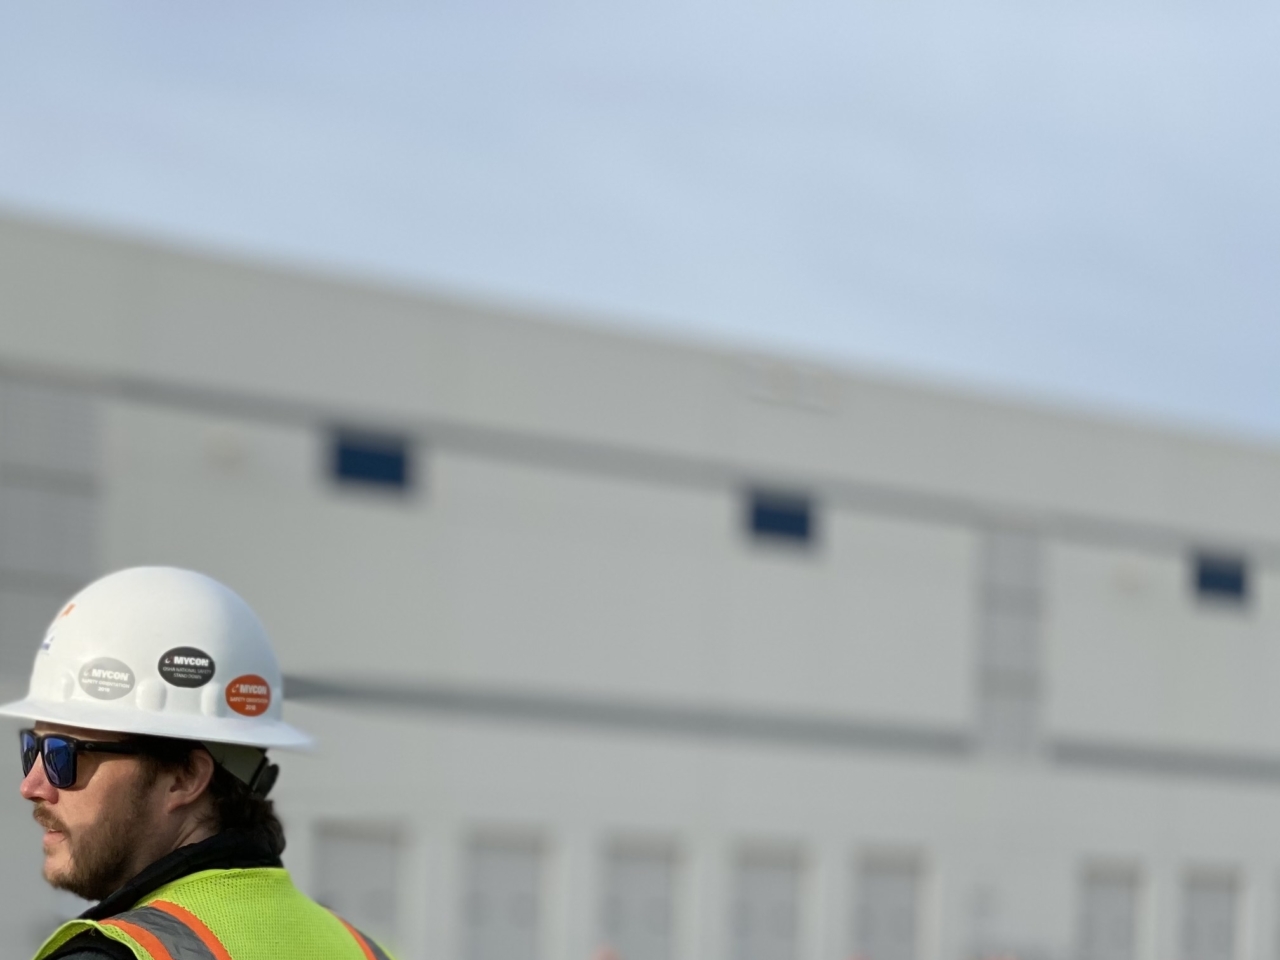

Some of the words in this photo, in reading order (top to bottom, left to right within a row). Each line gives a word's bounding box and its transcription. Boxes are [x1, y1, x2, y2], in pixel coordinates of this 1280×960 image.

[174, 656, 209, 667] MYCON
[91, 668, 129, 682] MYCON
[239, 684, 267, 695] MYCON
